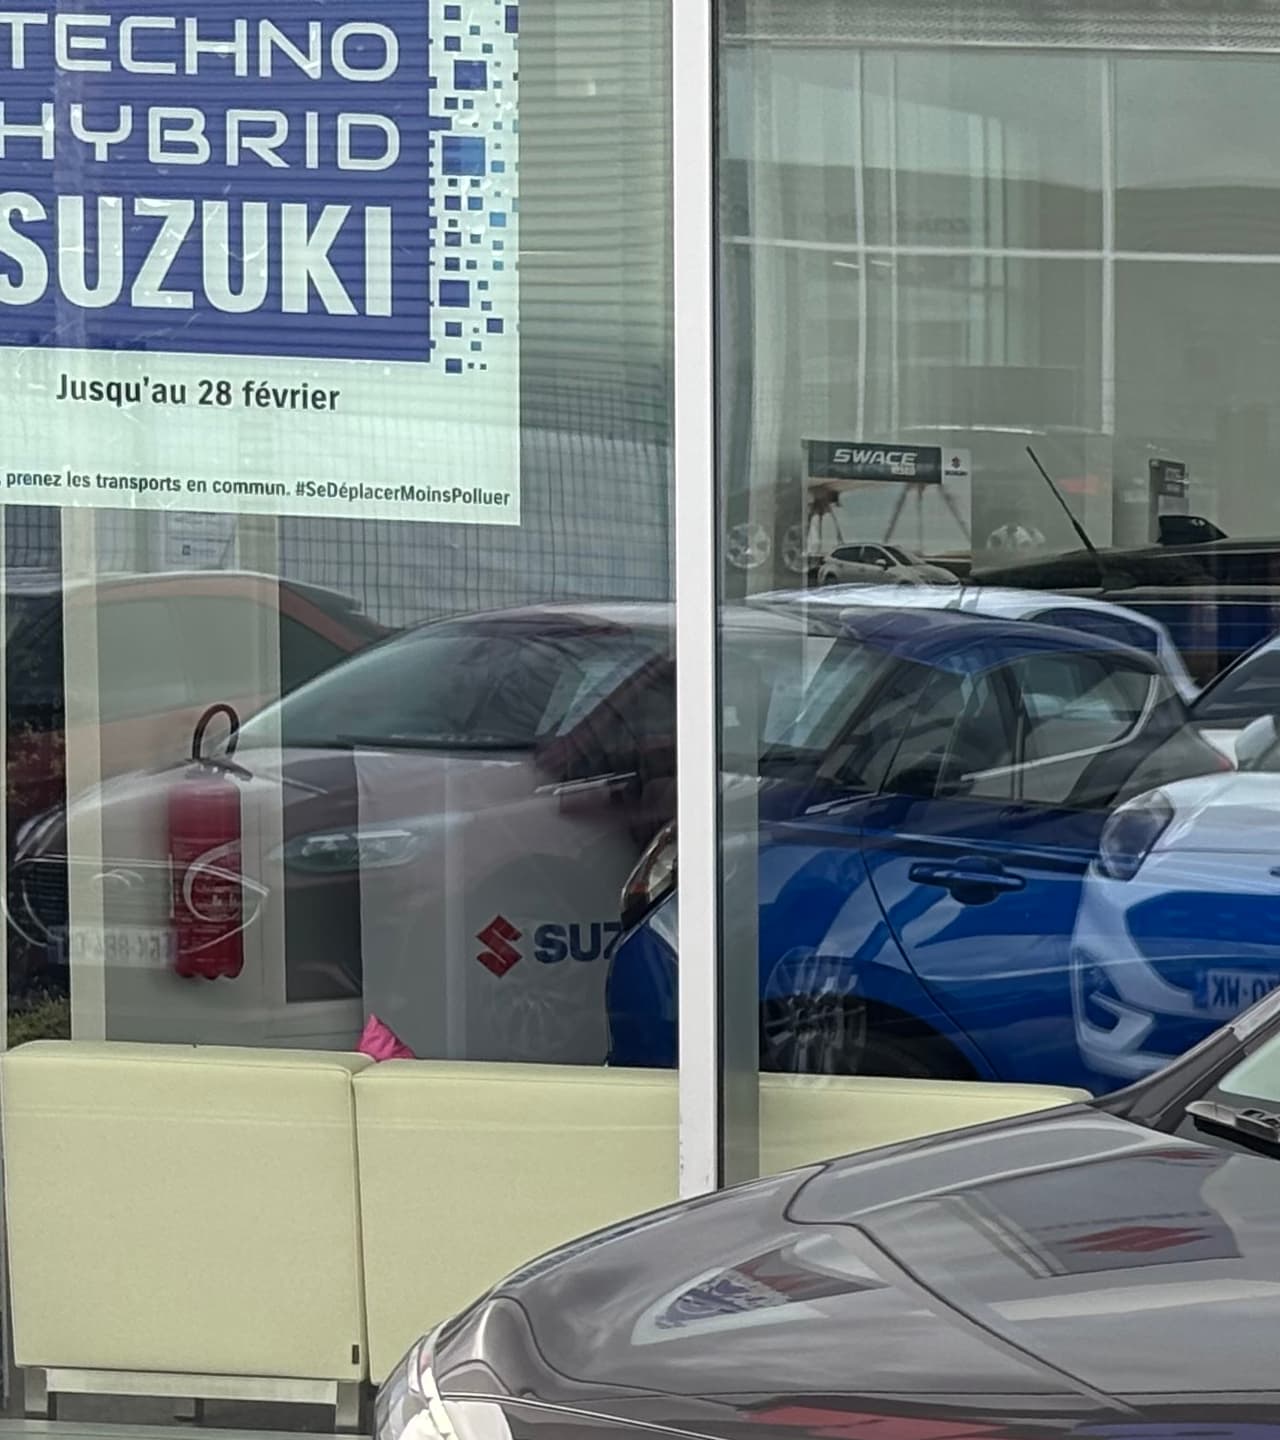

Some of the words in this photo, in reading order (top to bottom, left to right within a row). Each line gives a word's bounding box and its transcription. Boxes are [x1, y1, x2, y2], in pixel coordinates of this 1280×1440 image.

[0, 12, 400, 82] TECHNO
[0, 101, 400, 172] HYBRID
[0, 191, 393, 318] SUZUKI
[56, 372, 188, 408] Jusqu'au
[197, 380, 233, 407] 28
[242, 381, 341, 411] février
[6, 470, 62, 489] prenez
[67, 470, 91, 489] les
[96, 472, 182, 493] transports
[187, 479, 207, 494] en
[212, 479, 292, 497] commun.
[833, 448, 918, 467] SWACE
